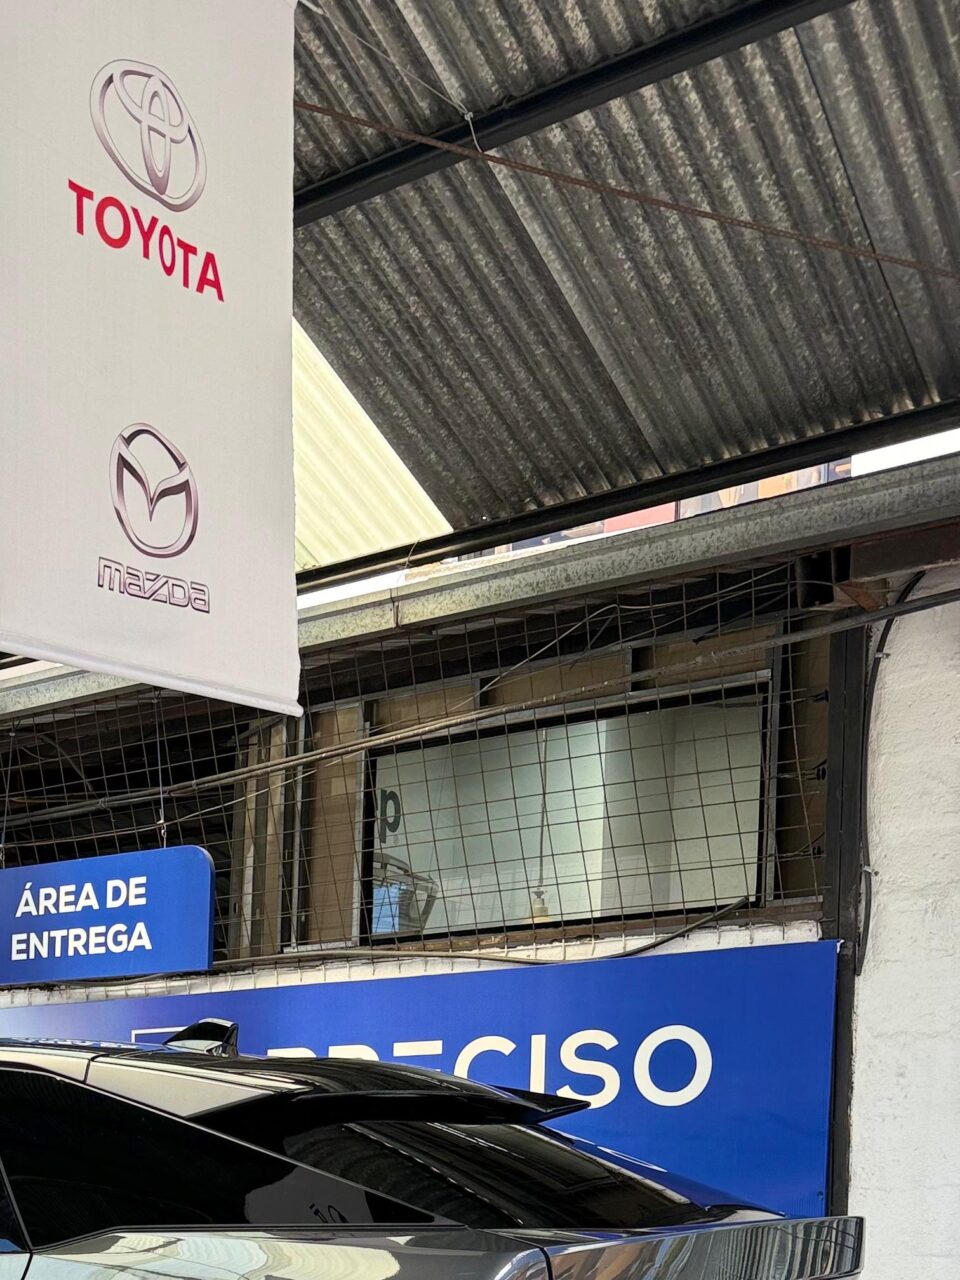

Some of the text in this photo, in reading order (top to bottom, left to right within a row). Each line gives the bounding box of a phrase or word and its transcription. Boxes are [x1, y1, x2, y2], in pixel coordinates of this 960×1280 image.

[67, 177, 225, 303] TOYOTA
[97, 556, 210, 614] mazda
[15, 876, 147, 918] ÁREA DE
[10, 921, 153, 961] ENTREGA
[266, 1024, 713, 1109] CISO
